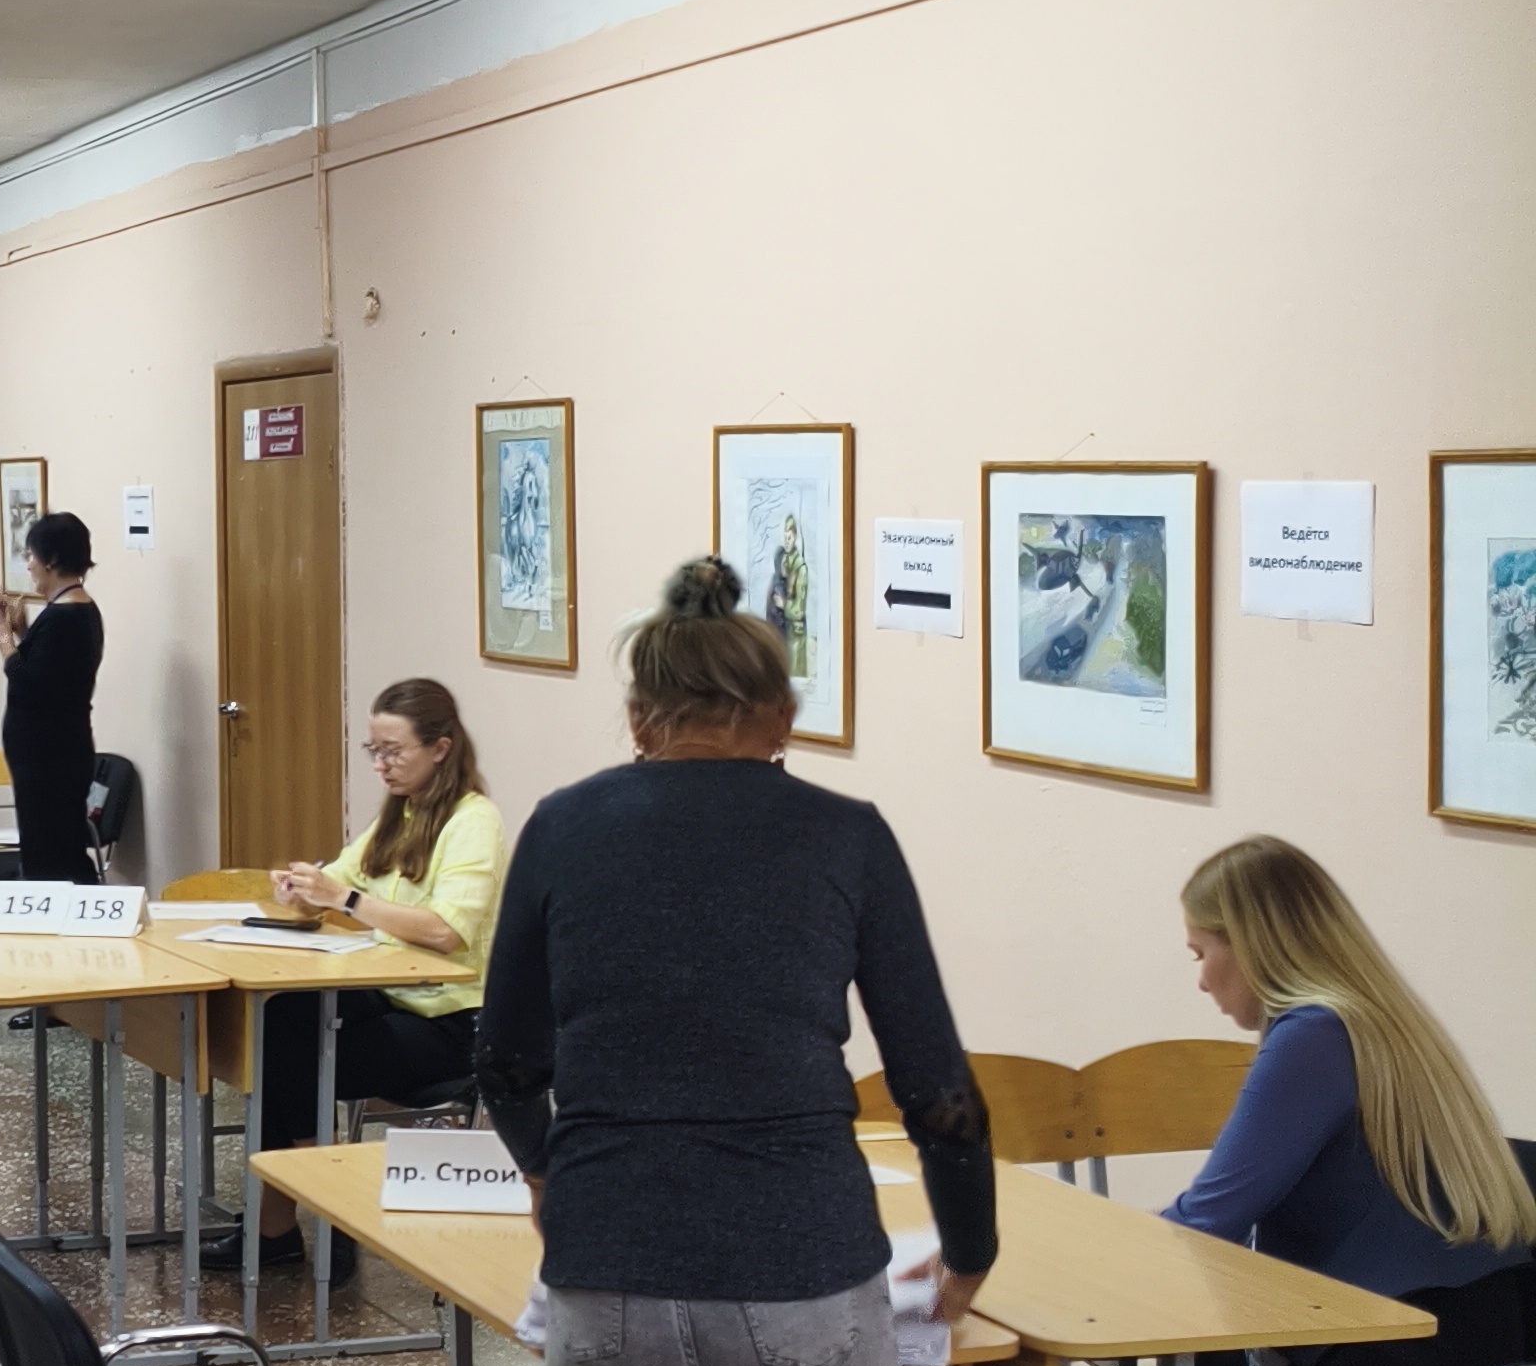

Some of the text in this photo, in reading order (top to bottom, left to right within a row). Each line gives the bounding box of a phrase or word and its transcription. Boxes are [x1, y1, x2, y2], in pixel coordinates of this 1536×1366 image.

[881, 530, 955, 548] Эвакуационный
[1281, 525, 1330, 543] Ведётся
[902, 560, 933, 576] выход
[1248, 555, 1363, 574] видеонаблюдение
[3, 896, 52, 915] 154
[76, 899, 125, 920] 158
[387, 1163, 521, 1185] пр. Строи
